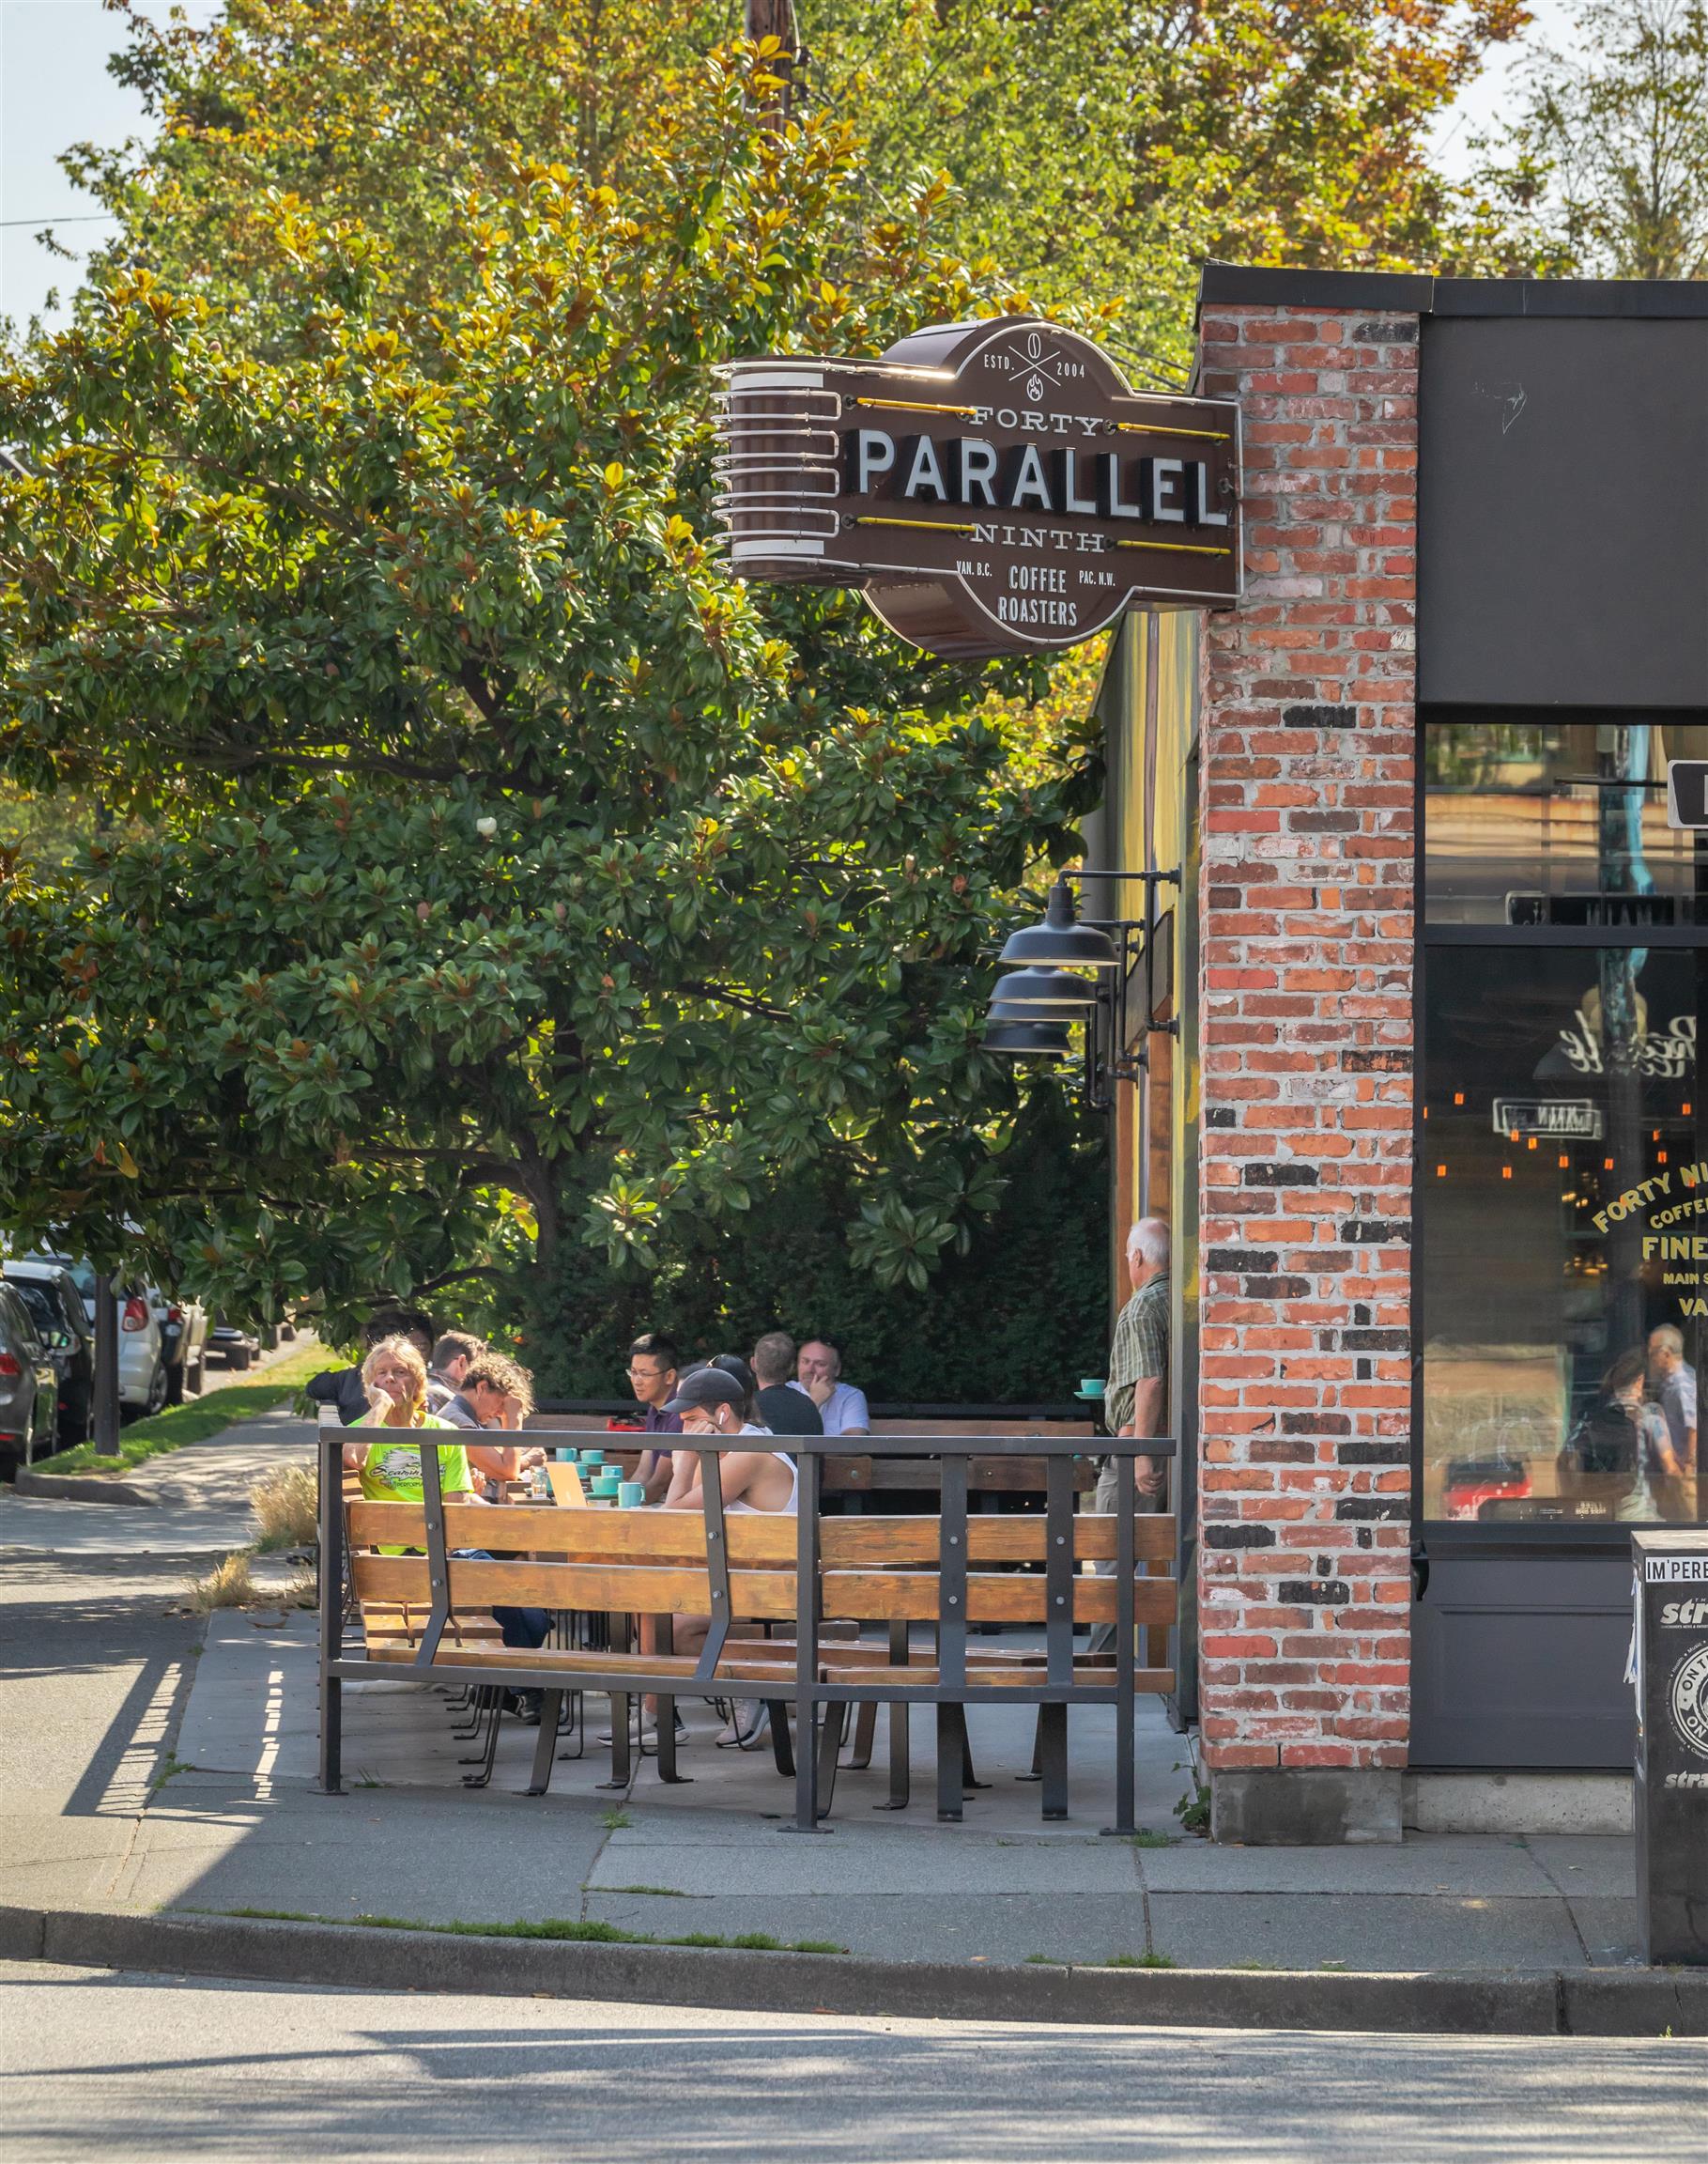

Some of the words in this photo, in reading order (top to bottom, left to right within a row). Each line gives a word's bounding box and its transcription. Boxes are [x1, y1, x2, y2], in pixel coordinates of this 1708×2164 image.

[984, 354, 1014, 371] ESTD.
[1057, 362, 1085, 378] 2004
[969, 406, 1103, 437] FORTY
[858, 428, 1228, 526] PARALLEL
[970, 523, 1104, 553] NINTH
[956, 561, 975, 576] VAN.
[977, 563, 992, 577] B.C.
[1008, 565, 1067, 594] COFFEE
[1079, 570, 1096, 585] PAC.
[1099, 572, 1116, 587] N.W.
[998, 596, 1077, 626] ROASTERS
[1592, 1171, 1671, 1234] FORTY
[1642, 1236, 1708, 1260] FINE
[1663, 1273, 1700, 1285] MAIN
[1678, 1298, 1708, 1317] VA
[1683, 1668, 1700, 1691] ON
[1686, 1716, 1707, 1739] ON
